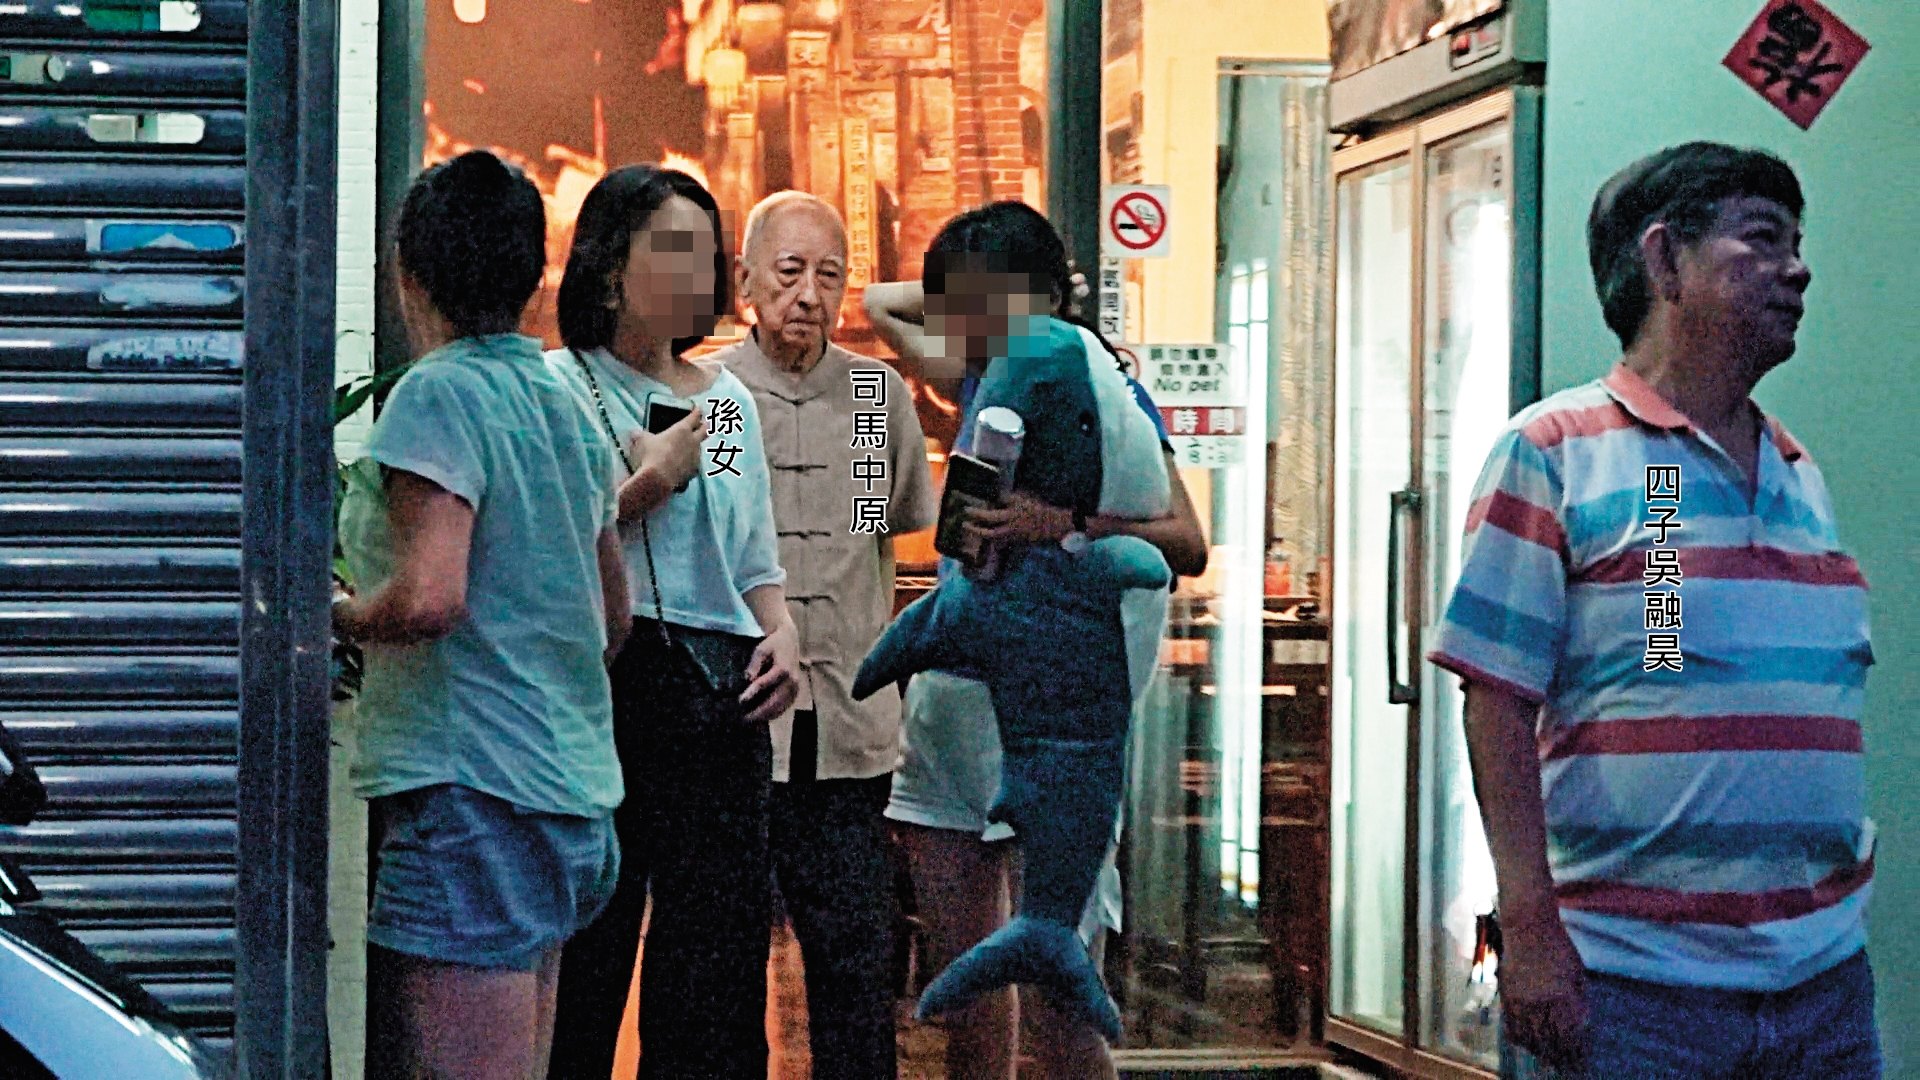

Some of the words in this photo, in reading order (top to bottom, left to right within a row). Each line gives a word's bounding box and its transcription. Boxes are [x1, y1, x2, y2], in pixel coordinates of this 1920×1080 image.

[1153, 377, 1182, 392] No
[1188, 378, 1221, 395] pet
[1172, 407, 1235, 434] 時間
